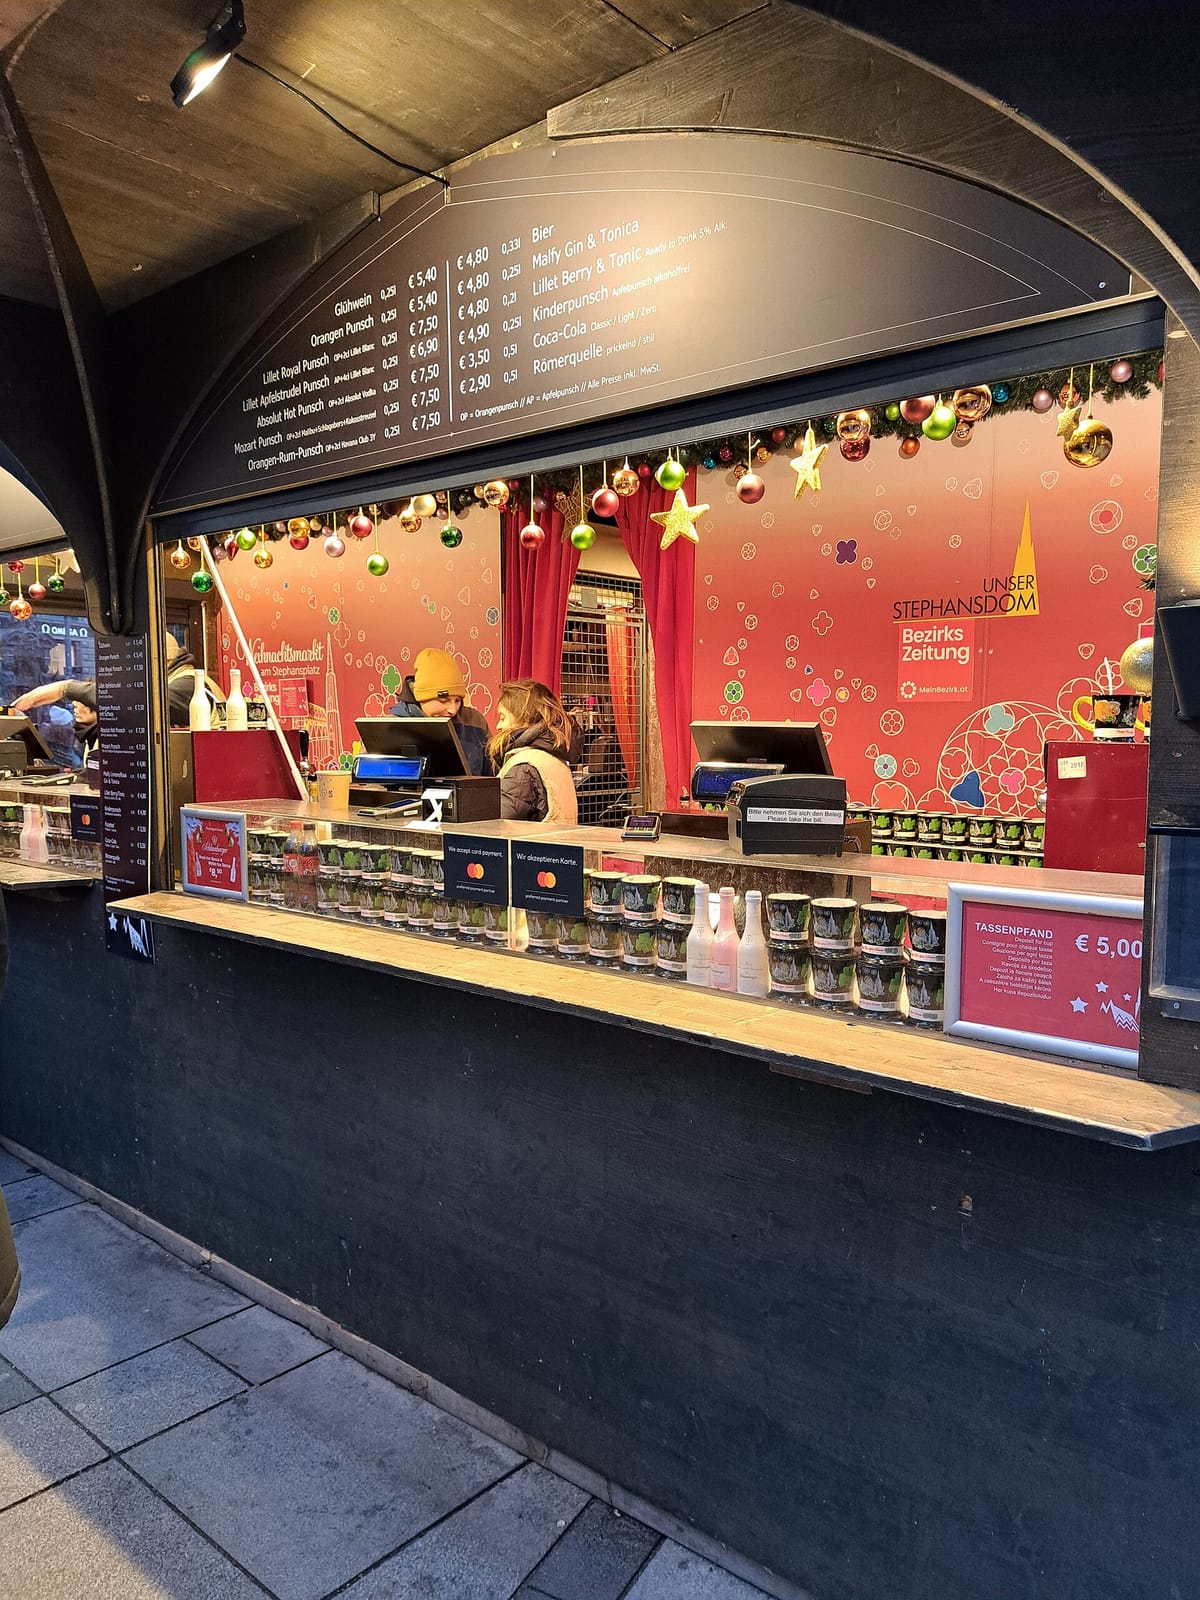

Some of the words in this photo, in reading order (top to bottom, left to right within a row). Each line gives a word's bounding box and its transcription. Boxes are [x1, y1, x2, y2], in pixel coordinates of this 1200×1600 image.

[457, 256, 463, 270] €
[466, 246, 488, 269] 4,80
[502, 237, 520, 255] 0,33l
[532, 225, 554, 243] Bier
[458, 281, 464, 295] €
[467, 272, 489, 293] 4,80
[502, 264, 520, 280] 0,25l
[533, 247, 561, 269] Malfy
[565, 240, 583, 257] Gin
[588, 233, 596, 249] &
[600, 220, 638, 244] Tonica
[458, 306, 464, 320] €
[467, 298, 489, 319] 4,80
[503, 292, 516, 307] 0,2l
[533, 275, 558, 296] Lillet
[562, 265, 592, 286] Berry
[597, 258, 605, 274] &
[610, 246, 642, 269] Tonic
[646, 244, 667, 256] Ready
[678, 232, 697, 246] Drink
[699, 227, 711, 238] 5%
[311, 328, 344, 347] Orangen
[346, 314, 374, 335] Punsch
[381, 308, 397, 324] 0,25l
[409, 299, 415, 312] €
[418, 290, 437, 311] 5,40
[335, 293, 372, 316] Glühwein
[381, 285, 396, 300] 0,25l
[408, 274, 414, 288] €
[417, 266, 437, 287] 5,40
[459, 330, 465, 344] €
[468, 323, 489, 344] 4,90
[503, 316, 521, 332] 0,25l
[533, 285, 608, 322] Kinderpunsch
[612, 277, 651, 296] Apfelpunsch
[263, 370, 279, 384] Lillet
[281, 361, 301, 379] Royal
[303, 352, 329, 372] Punsch
[382, 332, 397, 347] 0,25l
[410, 322, 416, 336] €
[418, 315, 438, 335] 7,50
[460, 356, 465, 369] €
[469, 349, 490, 368] 3,50
[503, 343, 517, 358] 0,5l
[534, 320, 586, 348] Coca-Cola
[591, 319, 611, 331] Classic
[618, 311, 634, 323] Light
[641, 305, 656, 316] Zero
[460, 380, 466, 394] €
[469, 374, 490, 394] 2,90
[504, 369, 517, 384] 0,5l
[534, 343, 603, 375] Römerquelle
[607, 339, 636, 356] prickelnd
[643, 333, 655, 344] still
[243, 397, 258, 412] Lillet
[260, 383, 301, 408] Apfelstrudel
[303, 374, 330, 393] Punsch
[382, 355, 398, 370] 0,25l
[410, 344, 416, 358] €
[418, 338, 438, 357] 6,90
[257, 411, 282, 428] Absolut
[284, 408, 296, 420] Hot
[298, 398, 324, 417] Punsch
[383, 379, 398, 393] 0,25l
[411, 370, 417, 384] €
[420, 363, 439, 383] 7,50
[460, 412, 468, 421] OP
[475, 400, 518, 418] Orangenpunsch
[526, 395, 534, 405] AP
[542, 383, 579, 401] Apfelpunsch
[588, 380, 599, 389] Alle
[601, 374, 621, 386] Preise
[624, 369, 637, 380] inkl.
[640, 364, 661, 376] MwSt.
[234, 439, 257, 454] Mozart
[259, 432, 282, 448] Punsch
[384, 402, 399, 416] 0,25l
[411, 394, 417, 407] €
[420, 388, 440, 407] 7,50
[248, 442, 323, 471] Orangen-Rum-Punsch
[384, 425, 400, 439] 0,25l
[412, 417, 418, 430] €
[421, 412, 440, 430] 7,50
[893, 592, 1036, 619] STEPHANSDOM
[984, 575, 1034, 592] UNSER
[902, 625, 964, 644] Bezirks
[902, 644, 970, 664] Zeitung
[272, 665, 320, 677] Stephansplatz
[919, 686, 968, 694] MeinBezirk.at
[516, 852, 526, 860] Wir
[527, 854, 559, 863] akzeptieren
[560, 857, 578, 866] Karte.
[975, 922, 1053, 939] TASSENPFAND
[1075, 934, 1088, 952] €
[1097, 936, 1142, 958] 5,00
